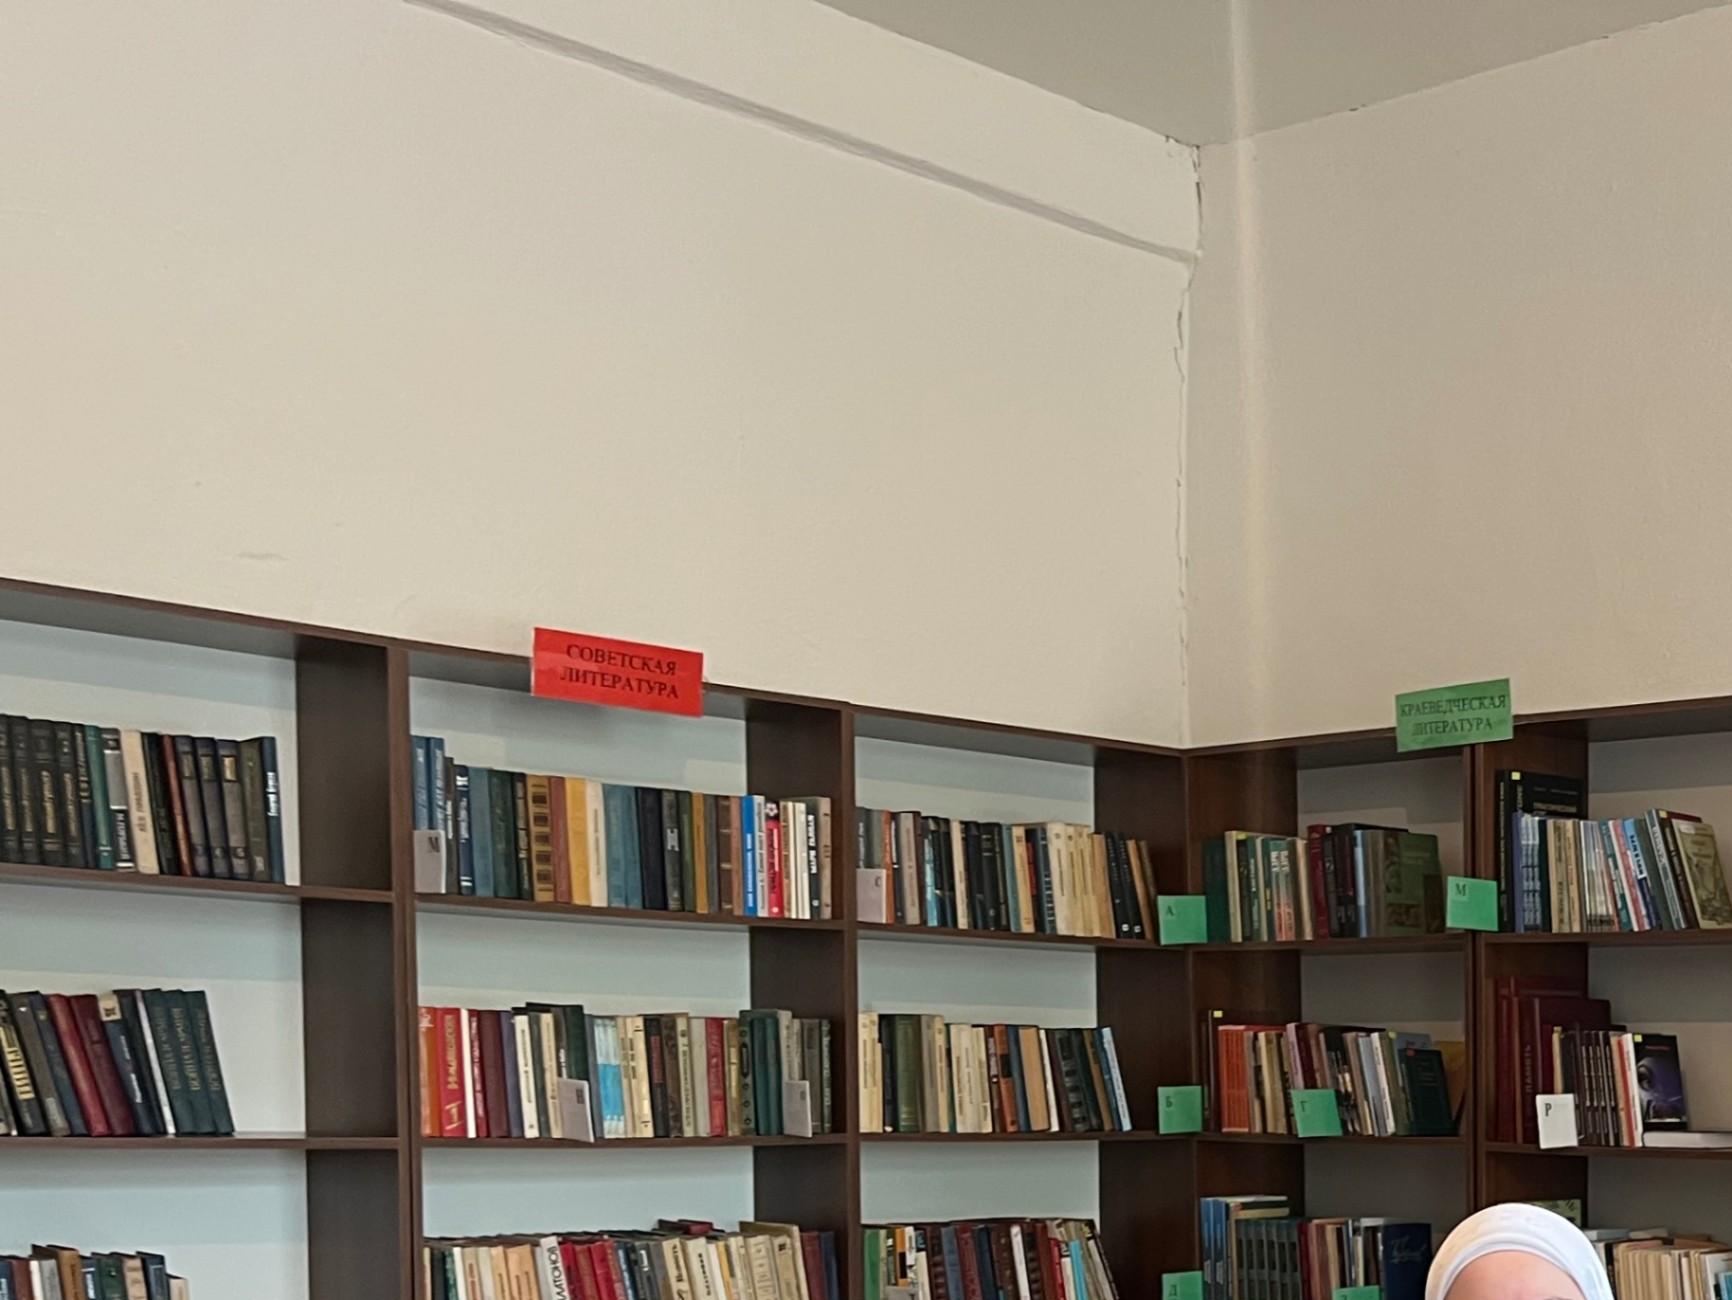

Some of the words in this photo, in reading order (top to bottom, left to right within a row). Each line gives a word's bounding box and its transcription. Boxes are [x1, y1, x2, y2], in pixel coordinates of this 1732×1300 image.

[566, 644, 677, 676] СОВЕТСКАЯ
[560, 666, 679, 699] ЛИТЕРАТУРА
[1400, 695, 1507, 717] КРАЕВЕДЧЕСКАЯ
[1412, 717, 1493, 736] ЛИТЕРАТУРА
[1455, 883, 1467, 896] М
[1165, 906, 1175, 916] А
[1165, 1097, 1173, 1107] Б
[1544, 1102, 1552, 1117] Р
